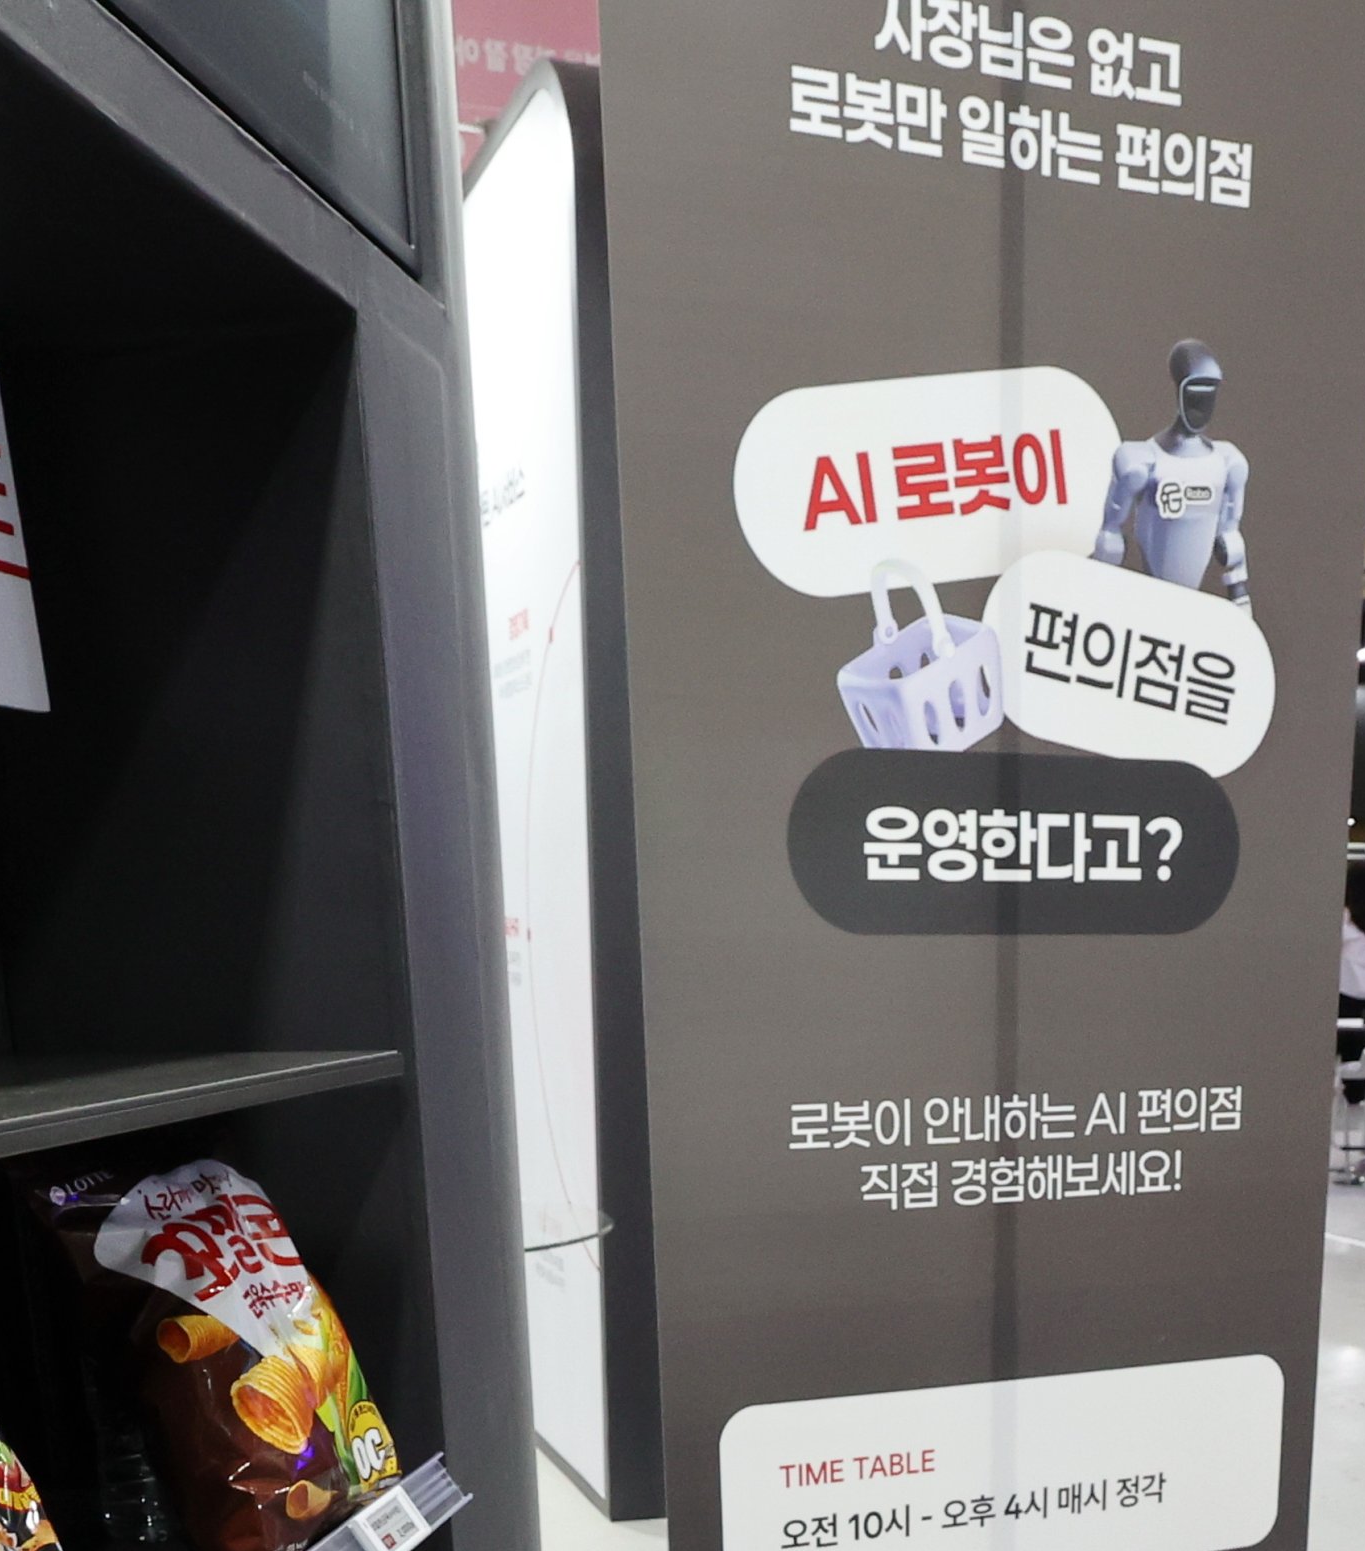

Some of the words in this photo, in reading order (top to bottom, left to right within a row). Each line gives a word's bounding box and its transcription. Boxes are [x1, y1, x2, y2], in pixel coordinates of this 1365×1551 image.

[874, 0, 1074, 90] 사장님은
[1087, 35, 1183, 107] 없고
[790, 64, 948, 159] 로봇만
[960, 97, 1102, 185] 일하는
[1115, 126, 1254, 208] 편의점
[803, 452, 878, 532] AI
[892, 429, 1068, 521] 로봇이
[1024, 602, 1237, 726] 편의점을
[862, 805, 1184, 884] 운영한다고?
[788, 1097, 913, 1151] 로봇이
[923, 1092, 1077, 1146] 안내하는
[1083, 1091, 1127, 1137] AI
[1136, 1084, 1244, 1137] 편의점
[860, 1160, 939, 1211] 직접
[950, 1149, 1184, 1208] 경험해보세요!
[779, 1458, 845, 1489] TIME
[852, 1448, 936, 1480] TABLE
[780, 1512, 839, 1551] 오전
[847, 1502, 911, 1543] 10시
[940, 1494, 996, 1531] 오후
[1003, 1486, 1048, 1522] 4시
[1056, 1478, 1108, 1514] 매시
[1114, 1471, 1167, 1507] 정각
